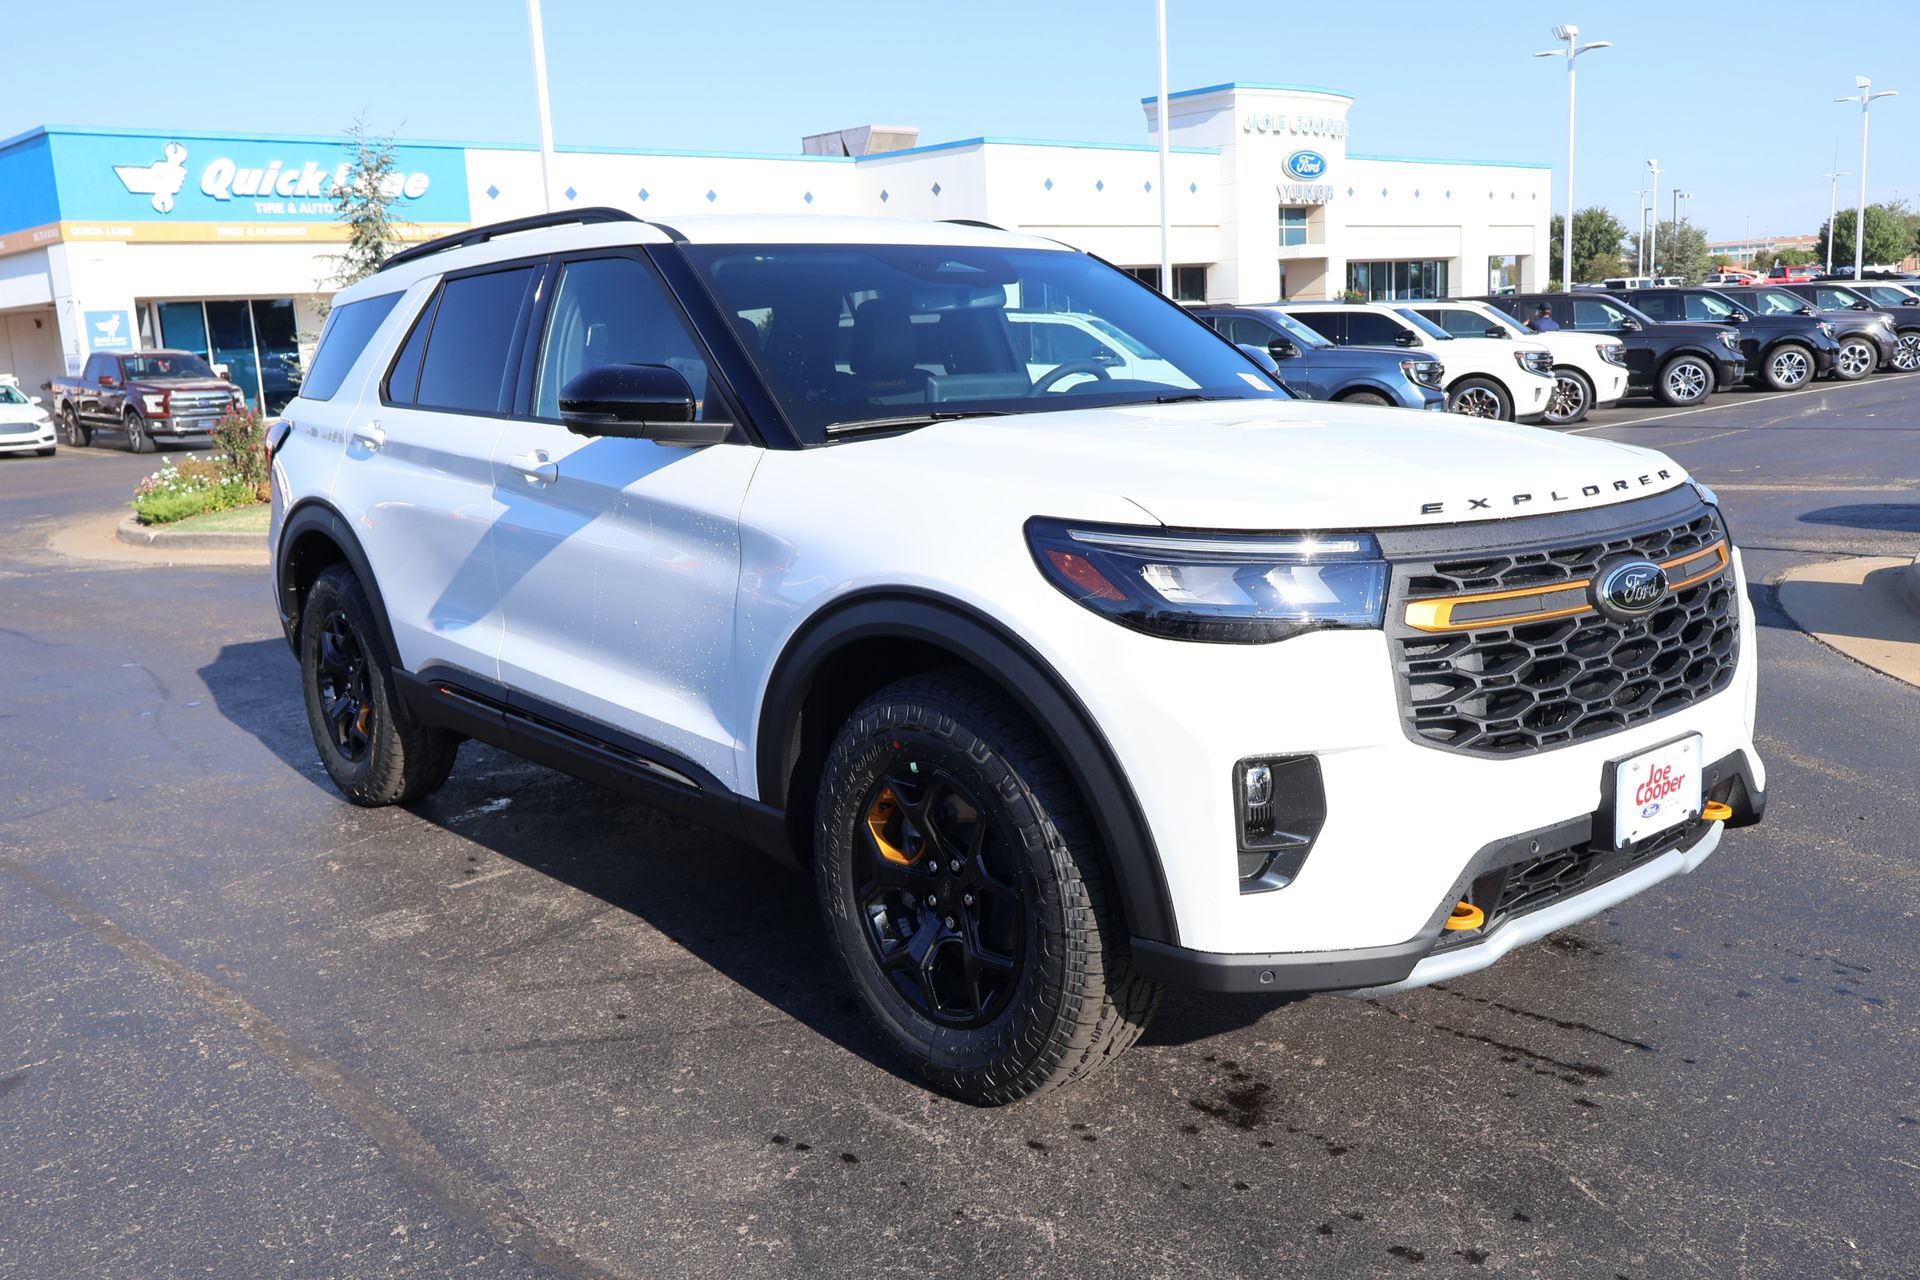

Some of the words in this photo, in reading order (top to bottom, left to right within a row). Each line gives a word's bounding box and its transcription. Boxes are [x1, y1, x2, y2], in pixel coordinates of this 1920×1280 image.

[200, 158, 330, 201] Quick
[1279, 184, 1334, 202] YUKON
[255, 203, 285, 214] TIRE
[287, 203, 298, 214] &
[300, 203, 333, 214] AUTO
[1421, 469, 1671, 515] EXPLORER
[1624, 573, 1659, 603] Ford
[1636, 774, 1685, 806] Cooper
[1646, 764, 1671, 787] Joe
